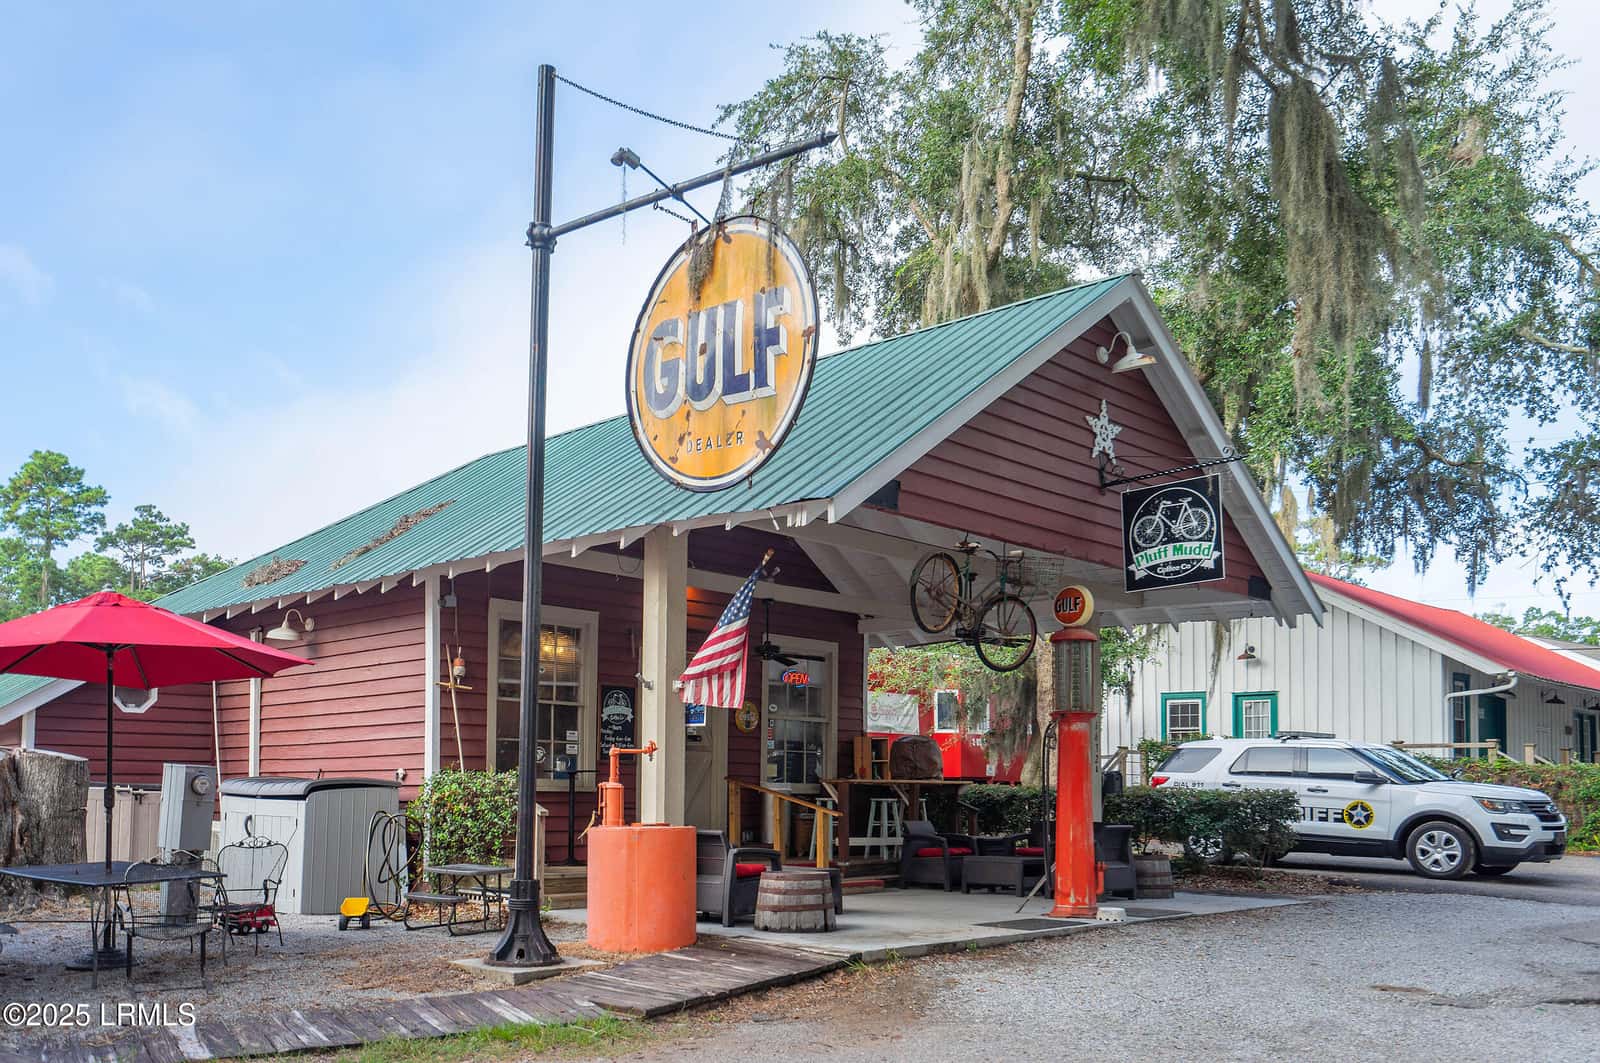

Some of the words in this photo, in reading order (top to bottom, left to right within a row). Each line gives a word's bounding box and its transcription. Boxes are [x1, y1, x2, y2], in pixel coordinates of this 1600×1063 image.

[644, 287, 792, 419] GULF
[686, 431, 744, 453] DEALER
[1135, 545, 1169, 568] Pluff
[1173, 543, 1212, 558] Mudd
[1055, 597, 1081, 614] GULF
[783, 671, 809, 685] OPEN
[1296, 806, 1345, 824] RIFF
